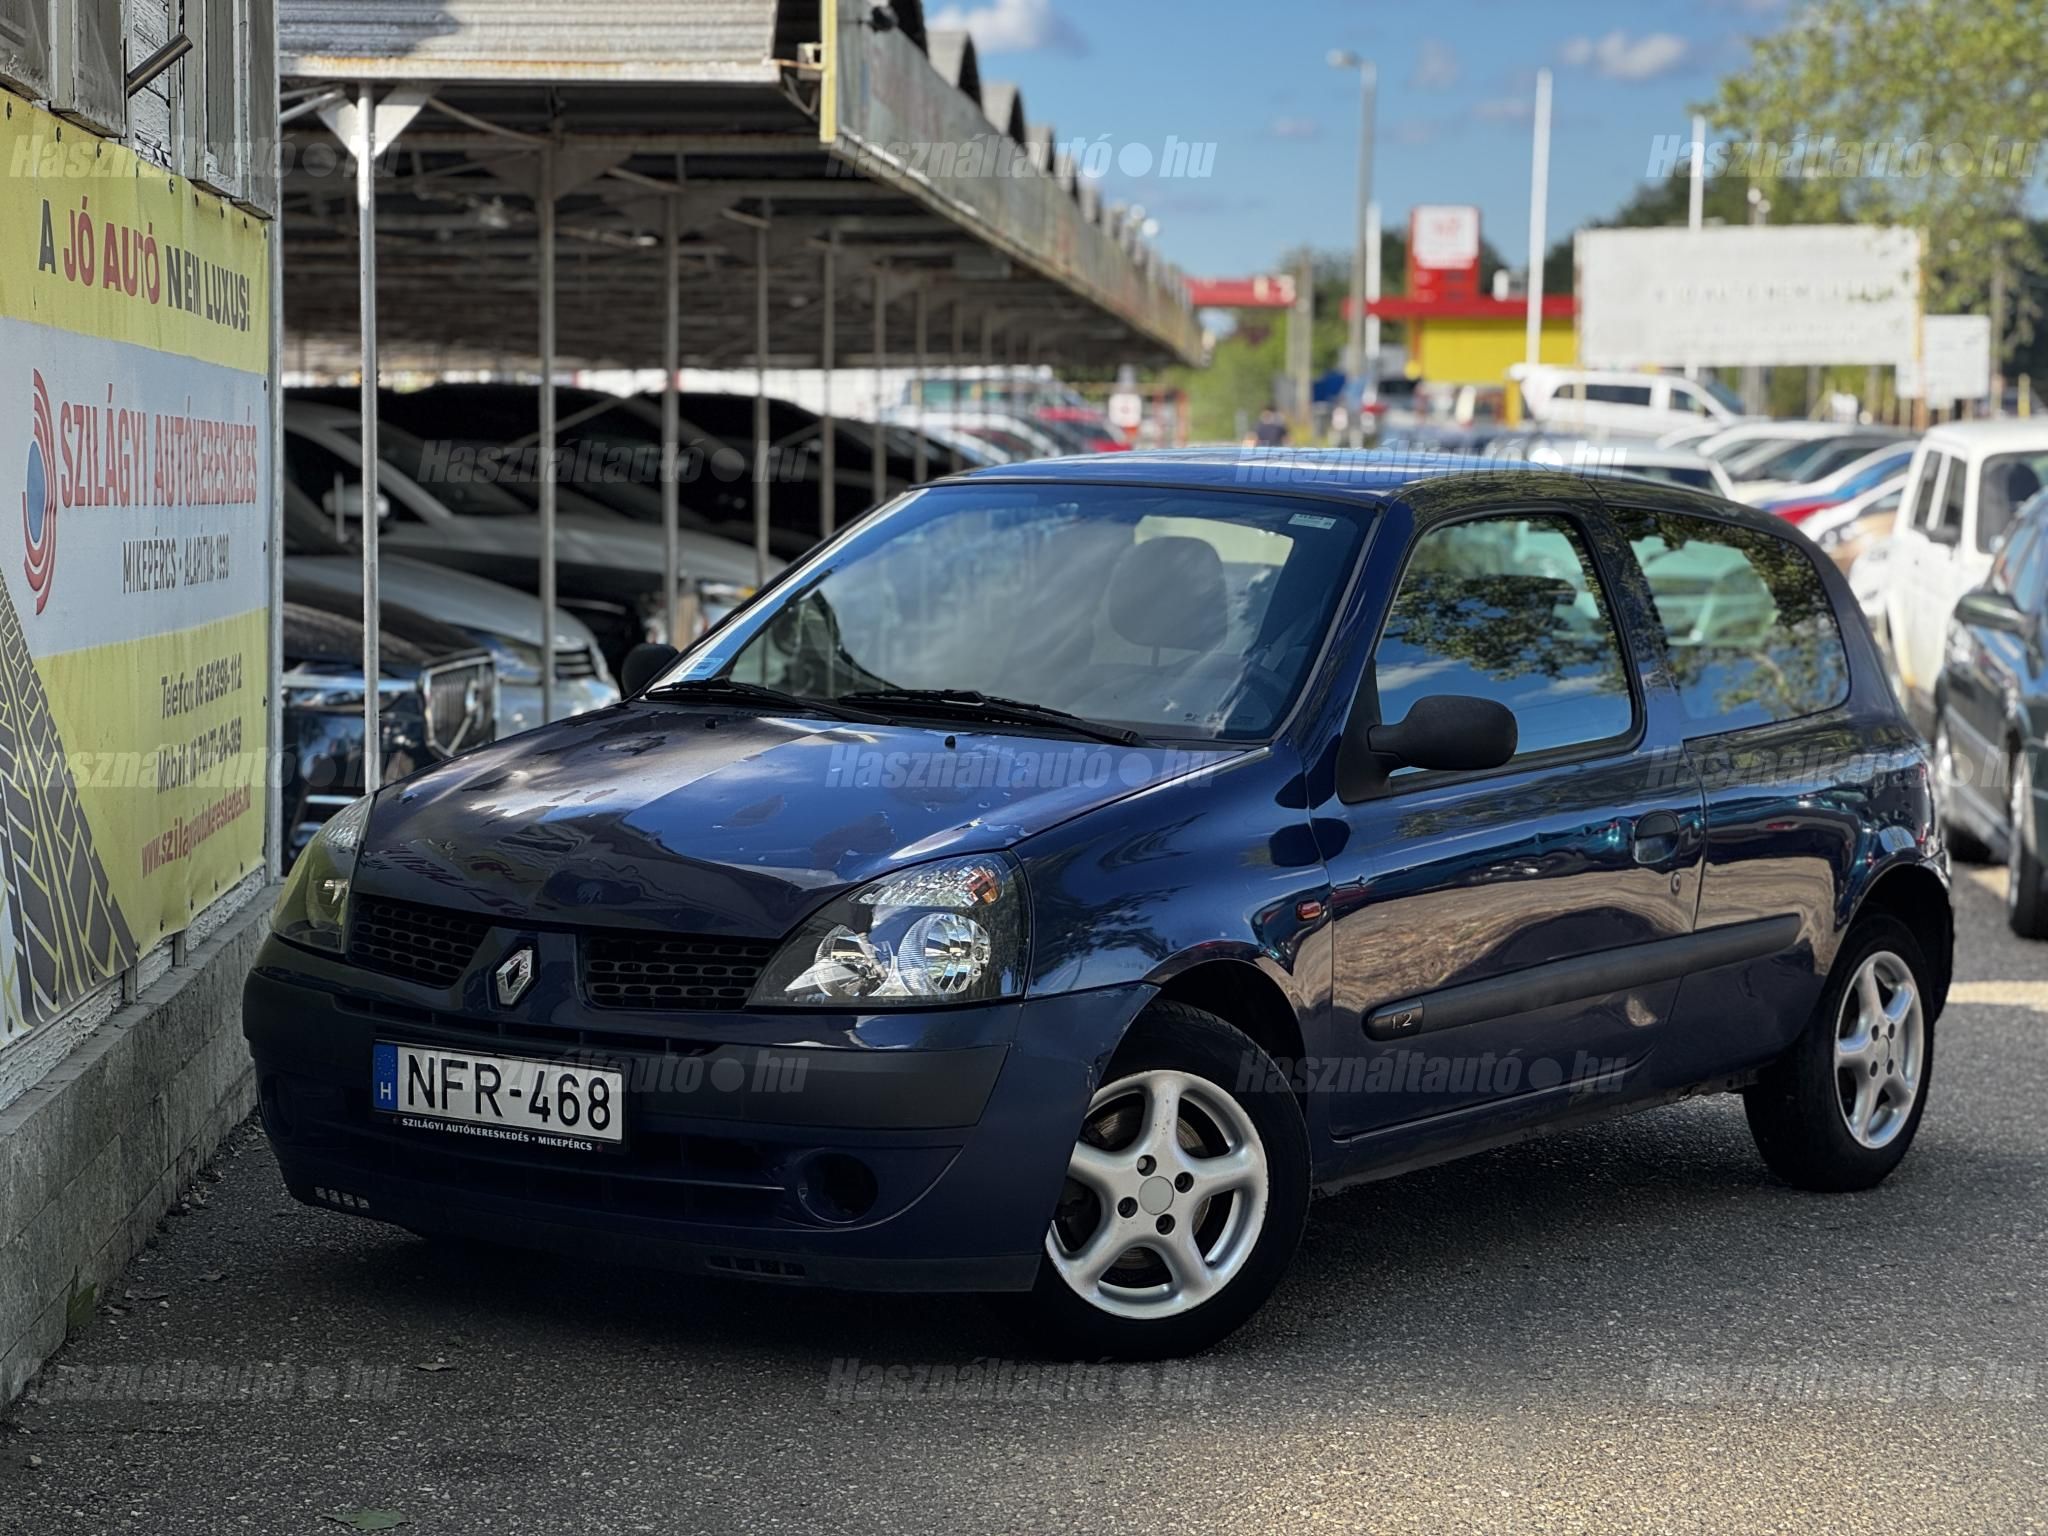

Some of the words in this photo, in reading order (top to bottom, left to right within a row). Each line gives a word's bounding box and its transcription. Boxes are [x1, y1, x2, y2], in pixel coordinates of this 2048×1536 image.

[38, 199, 57, 275] A
[63, 195, 95, 287] JÓ
[102, 222, 161, 305] AUTÓ
[165, 245, 201, 316] NEM
[204, 260, 251, 333] LUXUS!
[60, 382, 148, 508] SZILÁGYI
[153, 395, 258, 507] AUTÓKERESKEDÉS
[122, 524, 176, 595] MIKEPÉRCS
[1391, 1012, 1412, 1030] 1.2
[379, 1081, 392, 1101] H
[407, 1054, 611, 1131] NFR-468
[402, 1117, 444, 1132] SZILÁGYI
[446, 1123, 530, 1143] AUTÓKERESKEDÉS
[538, 1135, 593, 1151] MIKEPÉRCS
